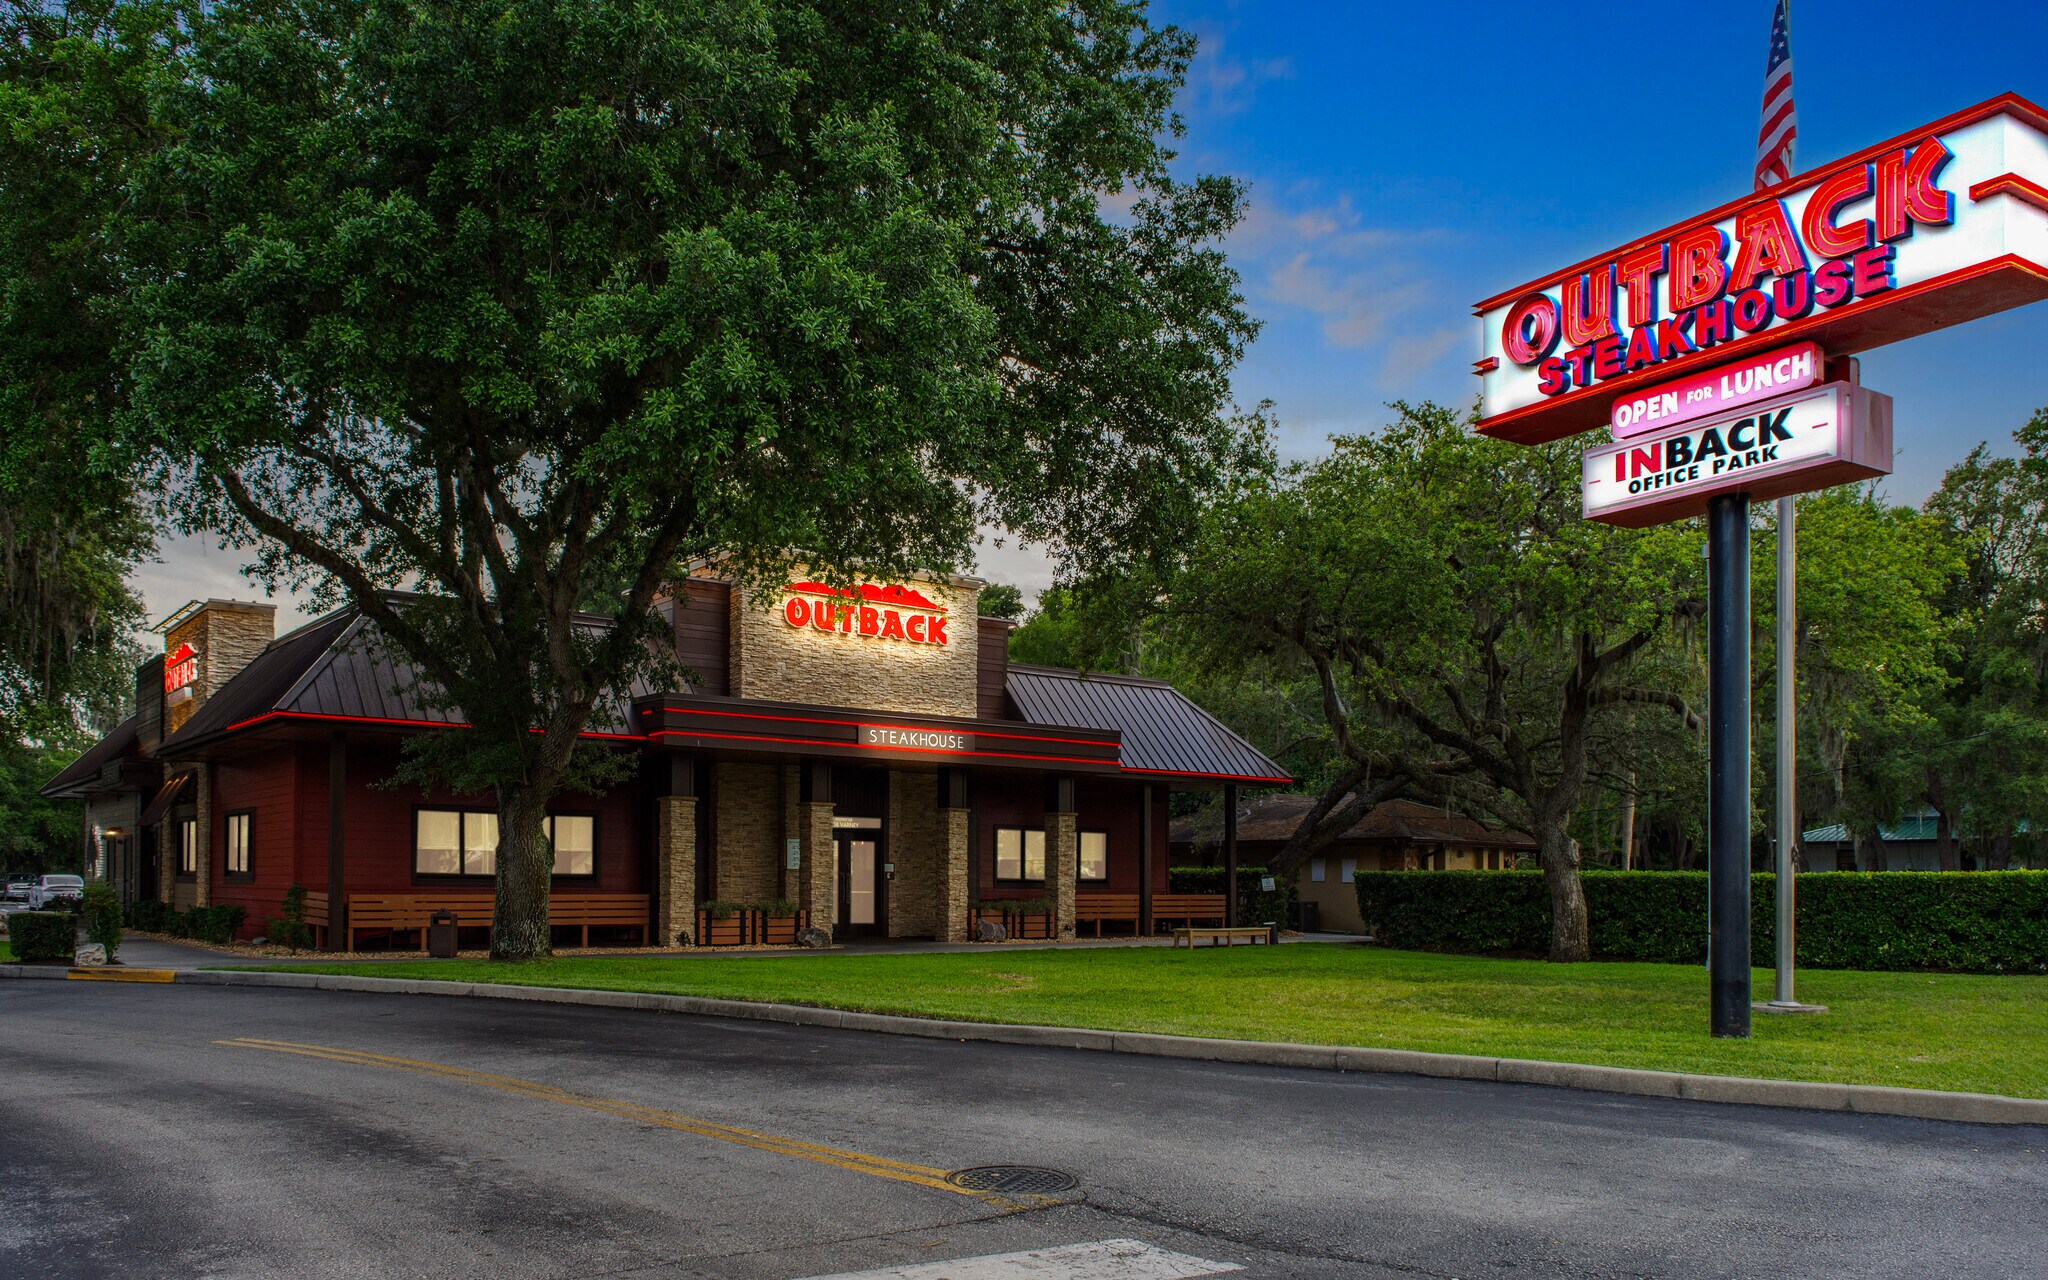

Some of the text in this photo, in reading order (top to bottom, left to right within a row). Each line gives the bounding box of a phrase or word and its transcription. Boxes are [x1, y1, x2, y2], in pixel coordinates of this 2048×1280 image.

[1502, 136, 1955, 367] OUTBACK
[1537, 245, 1897, 395] STEAKHOUSE
[1614, 350, 1812, 428] OPEN FOR LUNCH
[1615, 405, 1794, 483] INBACK
[1628, 445, 1778, 494] OFFICE PARK
[785, 597, 948, 646] OUTBACK
[869, 729, 964, 749] STEAKHOUSE
